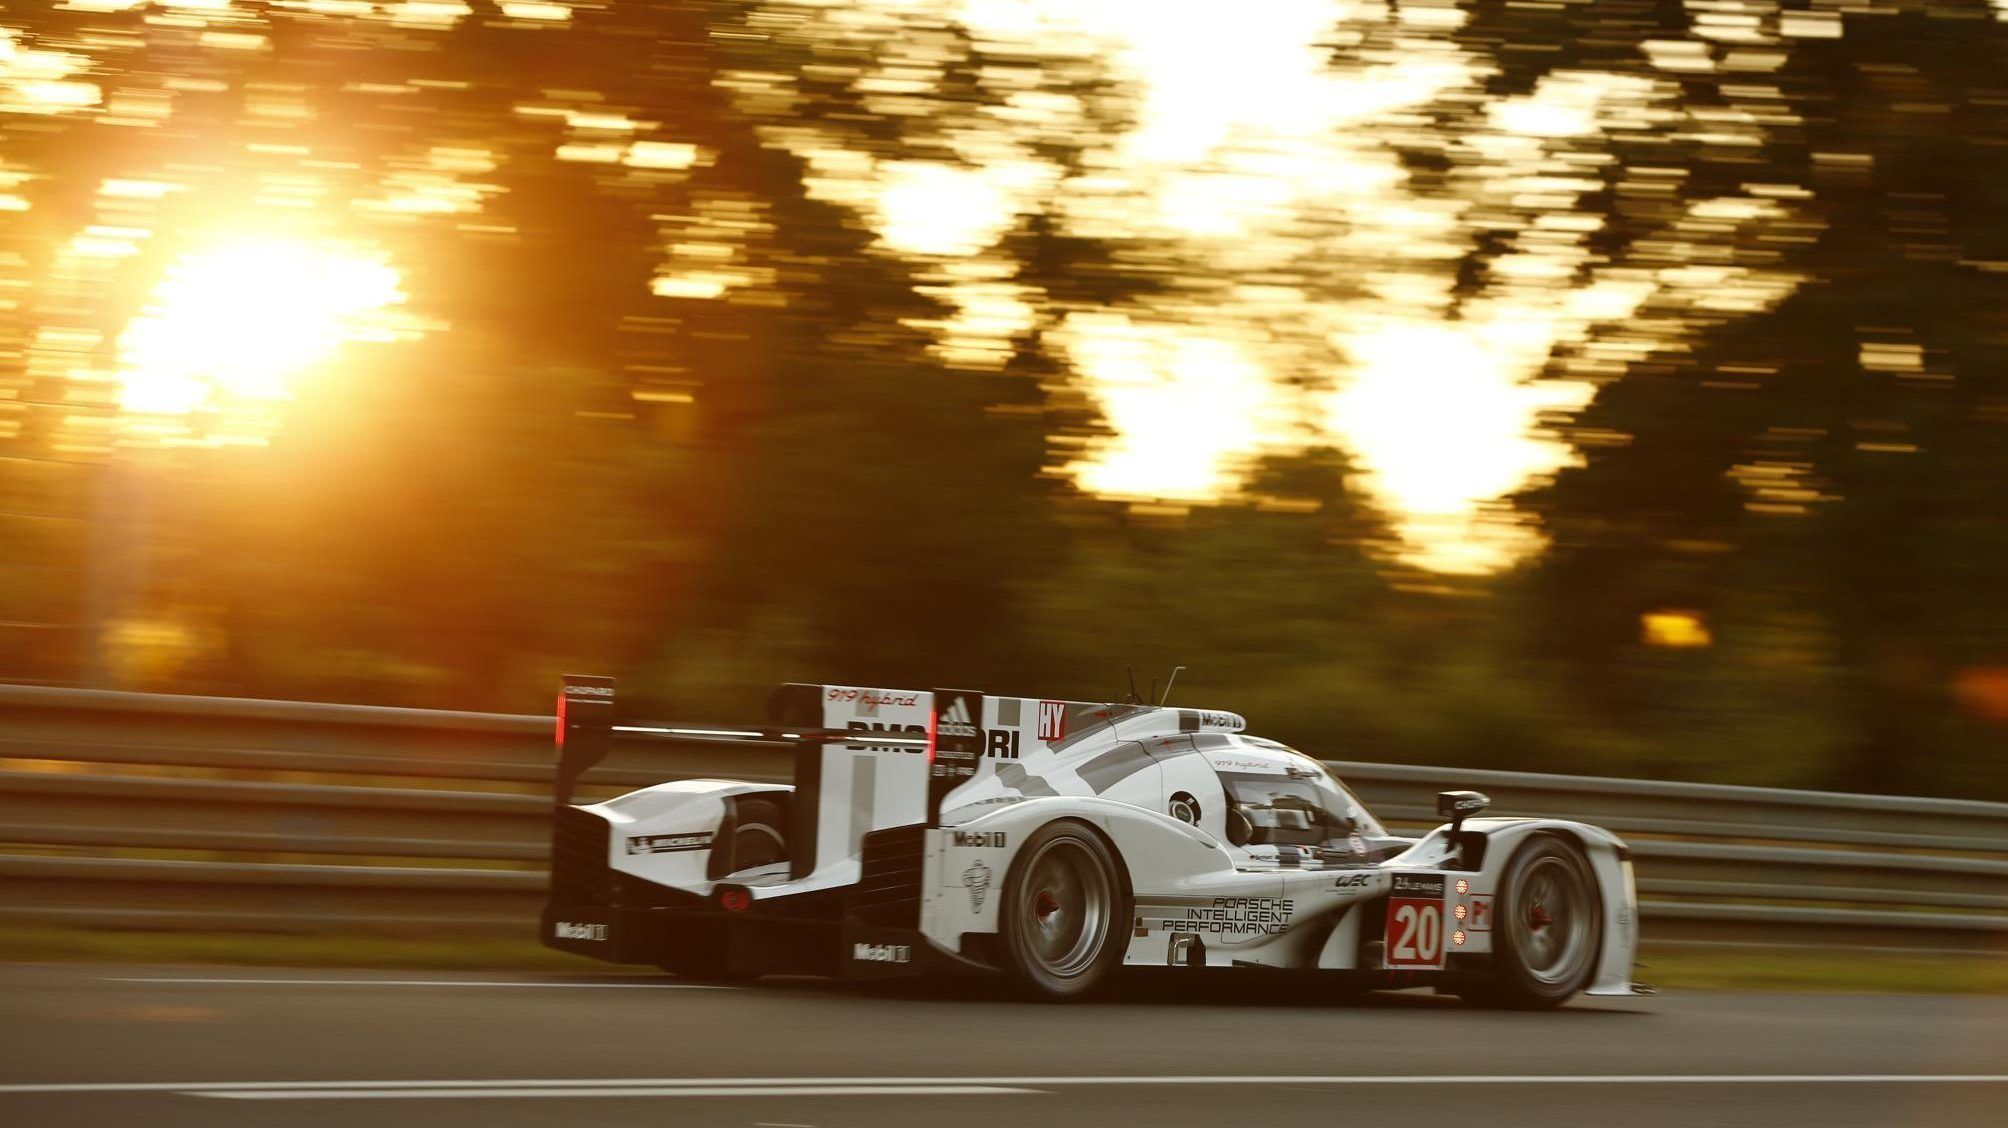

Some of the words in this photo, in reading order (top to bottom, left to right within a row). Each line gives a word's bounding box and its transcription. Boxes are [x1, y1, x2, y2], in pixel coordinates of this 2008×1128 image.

[828, 689, 857, 702] 919
[860, 692, 920, 712] hybrid
[1039, 702, 1065, 738] HY
[954, 831, 992, 848] Mobil
[1213, 897, 1294, 912] PORSCHE
[1187, 908, 1293, 923] INTELLIGENT
[555, 921, 594, 940] Mobil
[1162, 920, 1289, 935] PERFORMANCE
[1392, 904, 1440, 961] 20
[853, 942, 896, 962] Mobil
